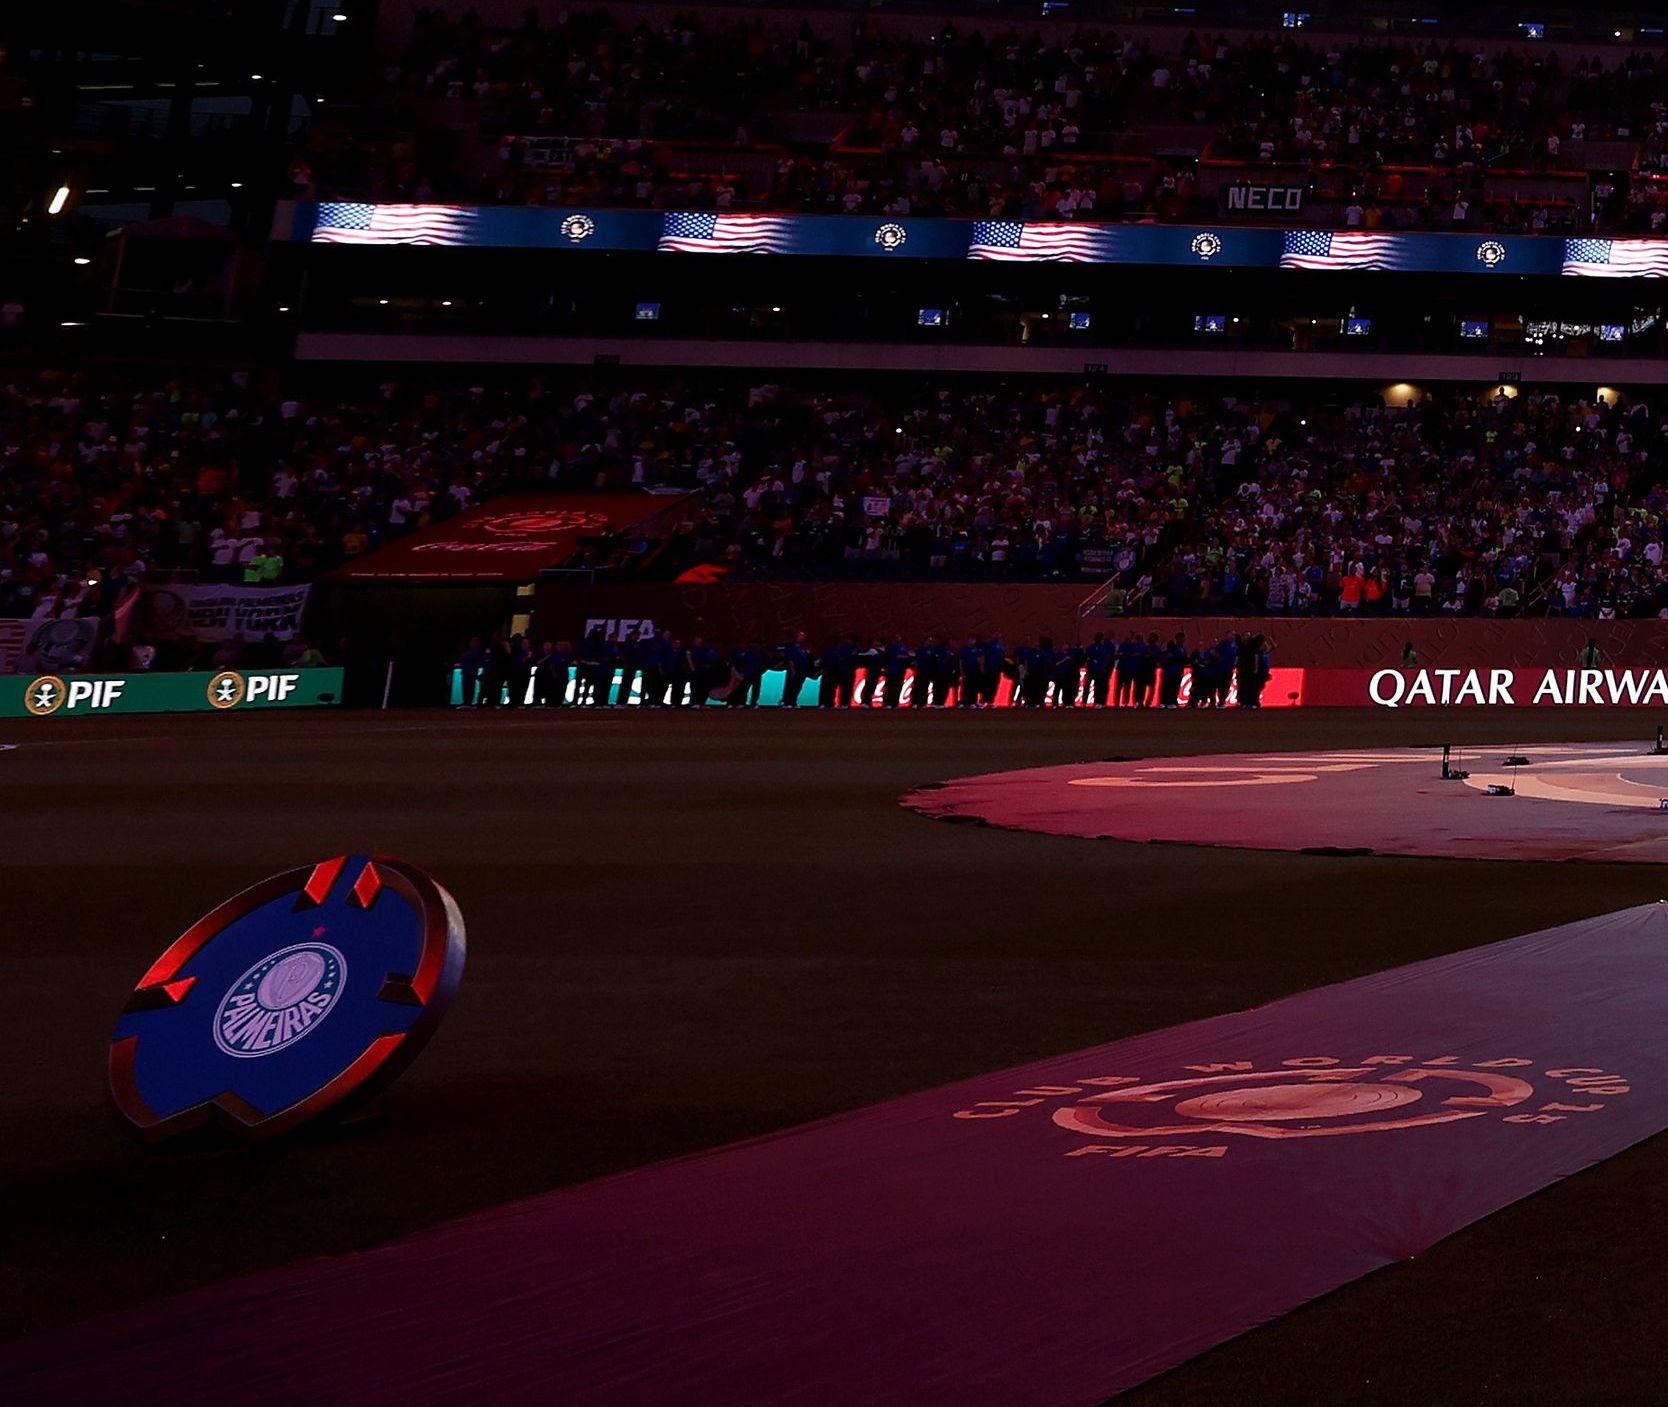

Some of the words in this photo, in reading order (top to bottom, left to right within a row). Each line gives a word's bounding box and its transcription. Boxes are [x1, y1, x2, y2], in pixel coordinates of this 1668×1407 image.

[1228, 186, 1302, 209] NECO
[584, 619, 655, 642] FIFA
[67, 680, 125, 708] PIF
[246, 674, 299, 702] PIF
[1369, 669, 1515, 707] QATAR
[222, 992, 331, 1050] PALMEIRAS
[952, 1076, 1141, 1119] CLUB
[1183, 1055, 1533, 1076] WORLD
[1064, 1145, 1229, 1158] FIFA
